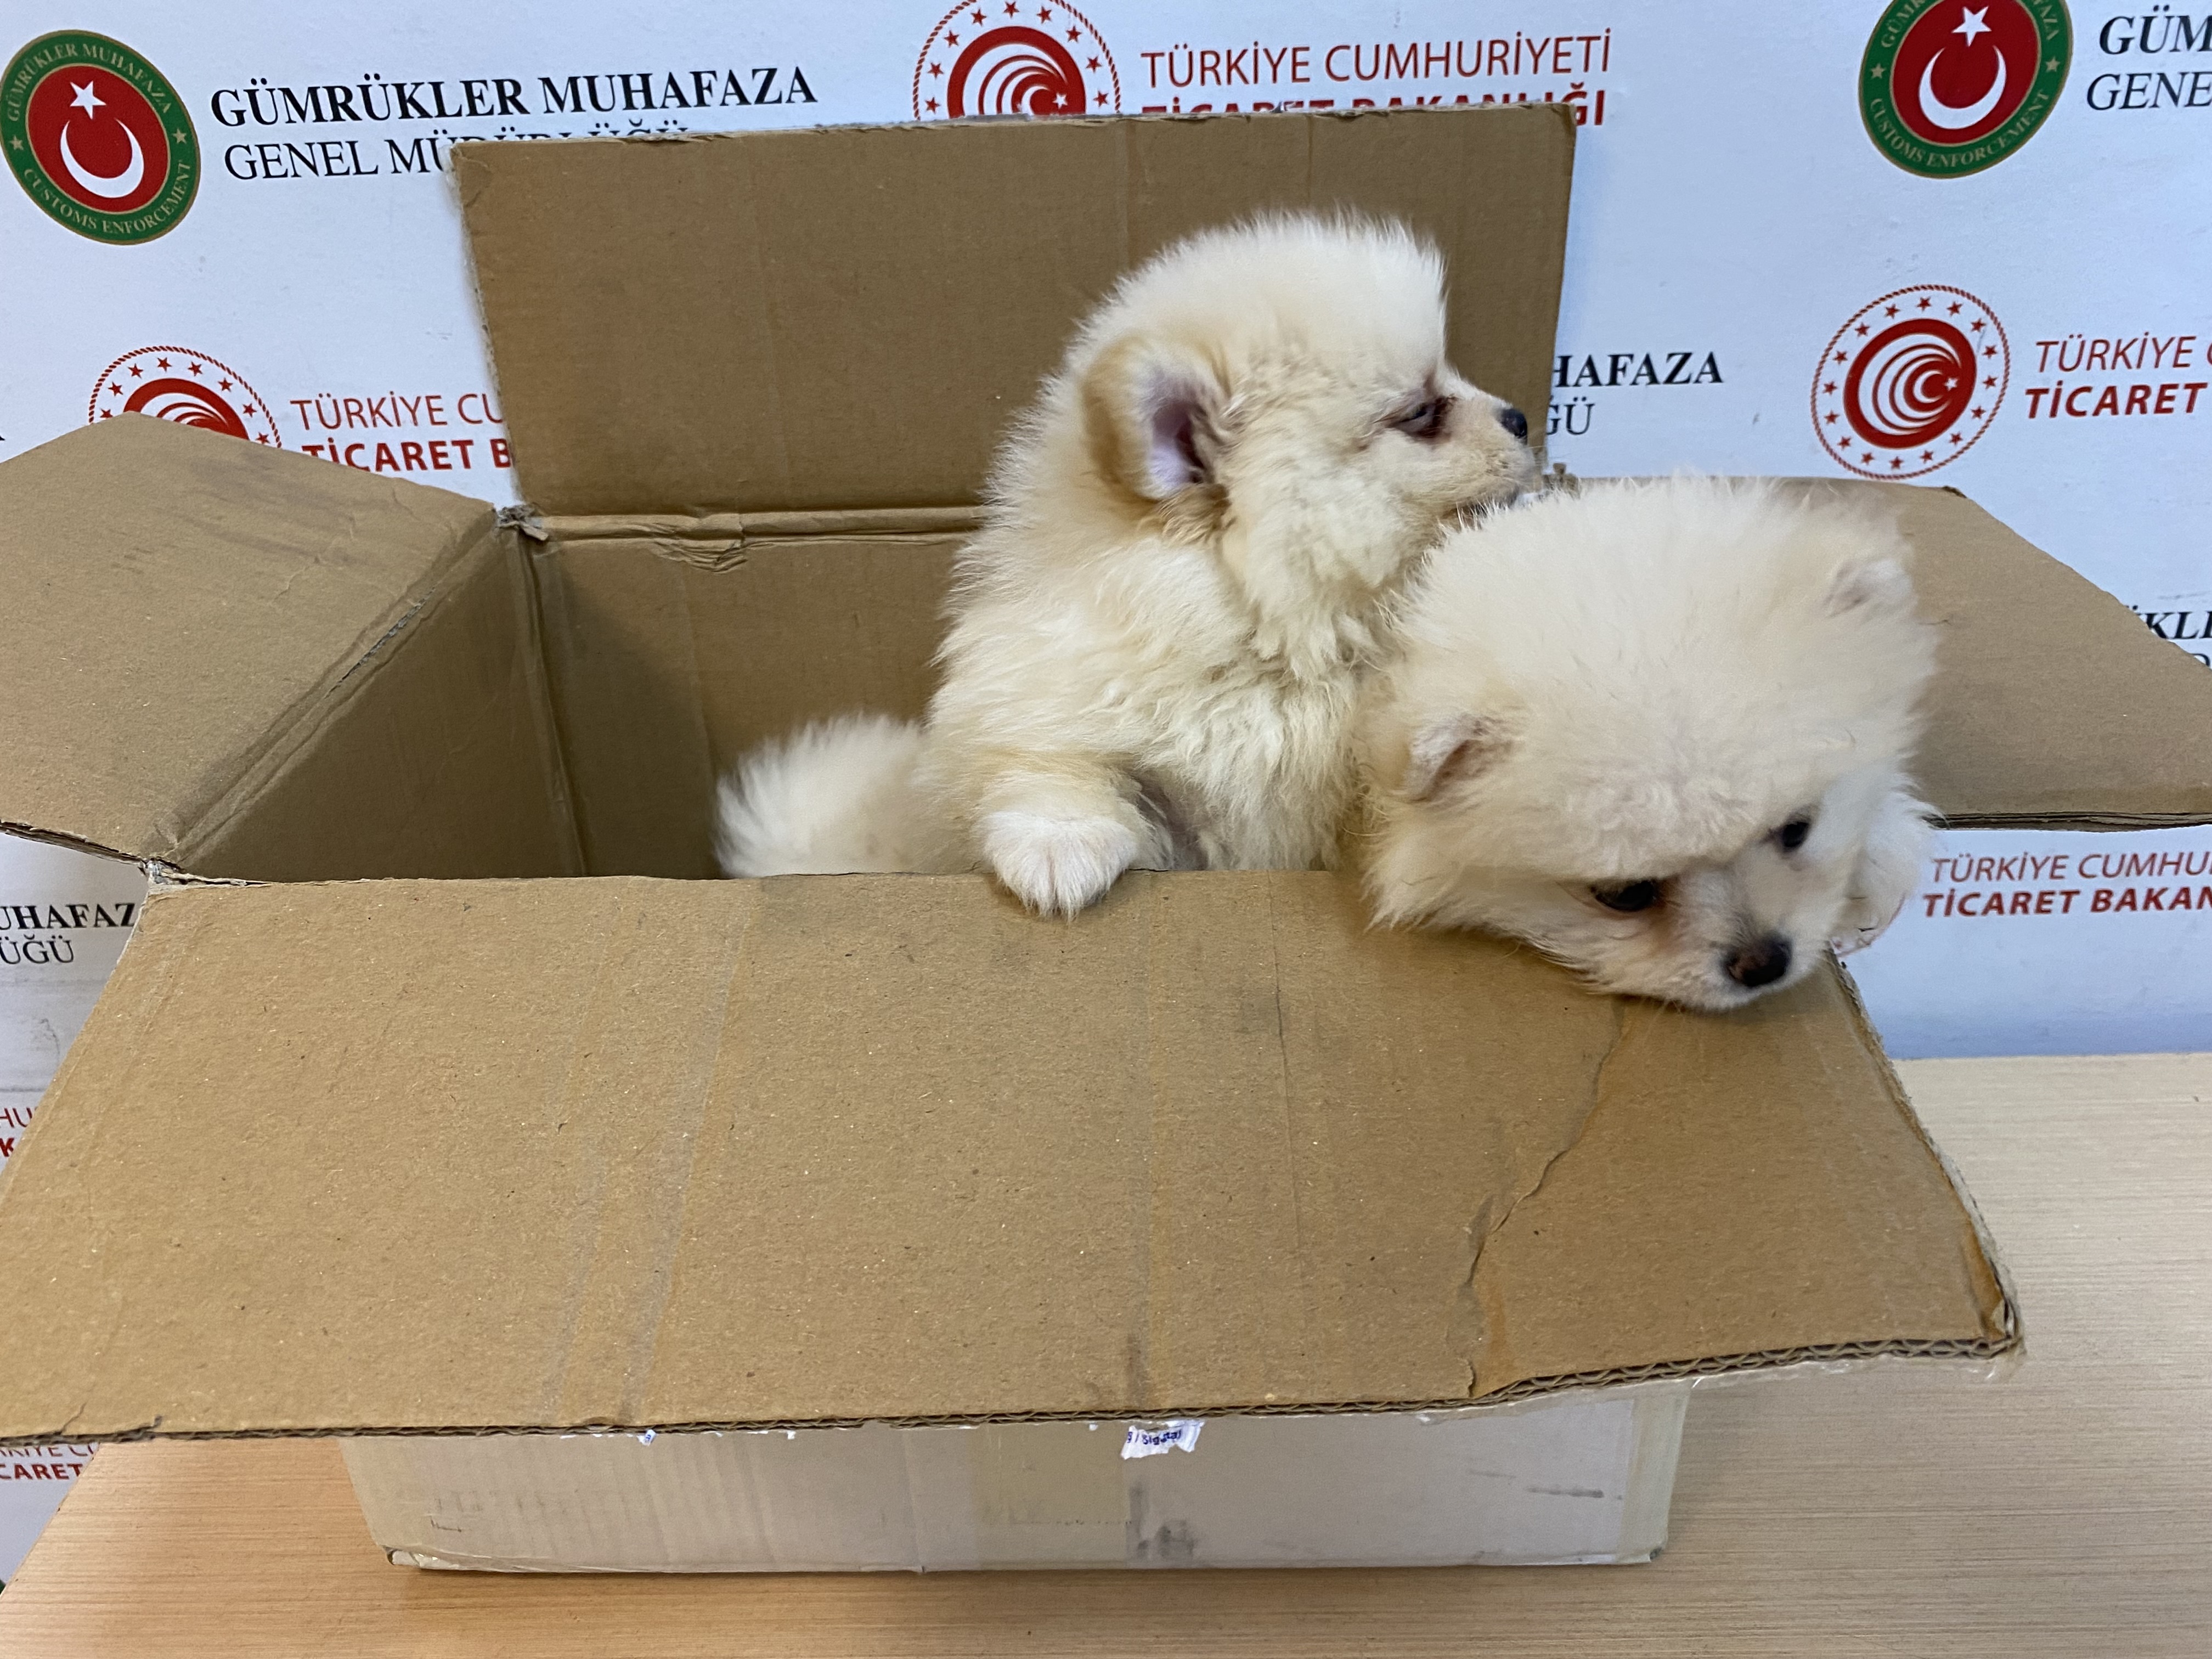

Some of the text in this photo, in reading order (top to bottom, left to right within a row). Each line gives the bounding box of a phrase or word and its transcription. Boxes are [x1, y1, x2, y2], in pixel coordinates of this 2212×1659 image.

[1141, 27, 1611, 88] TÜRKİYE CUMHURİYETİ
[7, 43, 172, 122] GÜMRÜKLER MUHAFAZA
[211, 66, 818, 127] GÜMRÜKLER MUHAFAZA
[1870, 89, 2050, 167] CUSTOMS ENFORCEMENT
[224, 139, 379, 180] GENEL
[24, 160, 191, 235] CUSTOMS ENFORCEMENT
[2035, 331, 2197, 373] TÜRKİYE
[290, 391, 448, 431] TÜRKİYE
[2025, 380, 2208, 419] TİCARET
[1932, 851, 2212, 883] TÜRKİYE CUMHU
[1923, 888, 2081, 917] TİCARET
